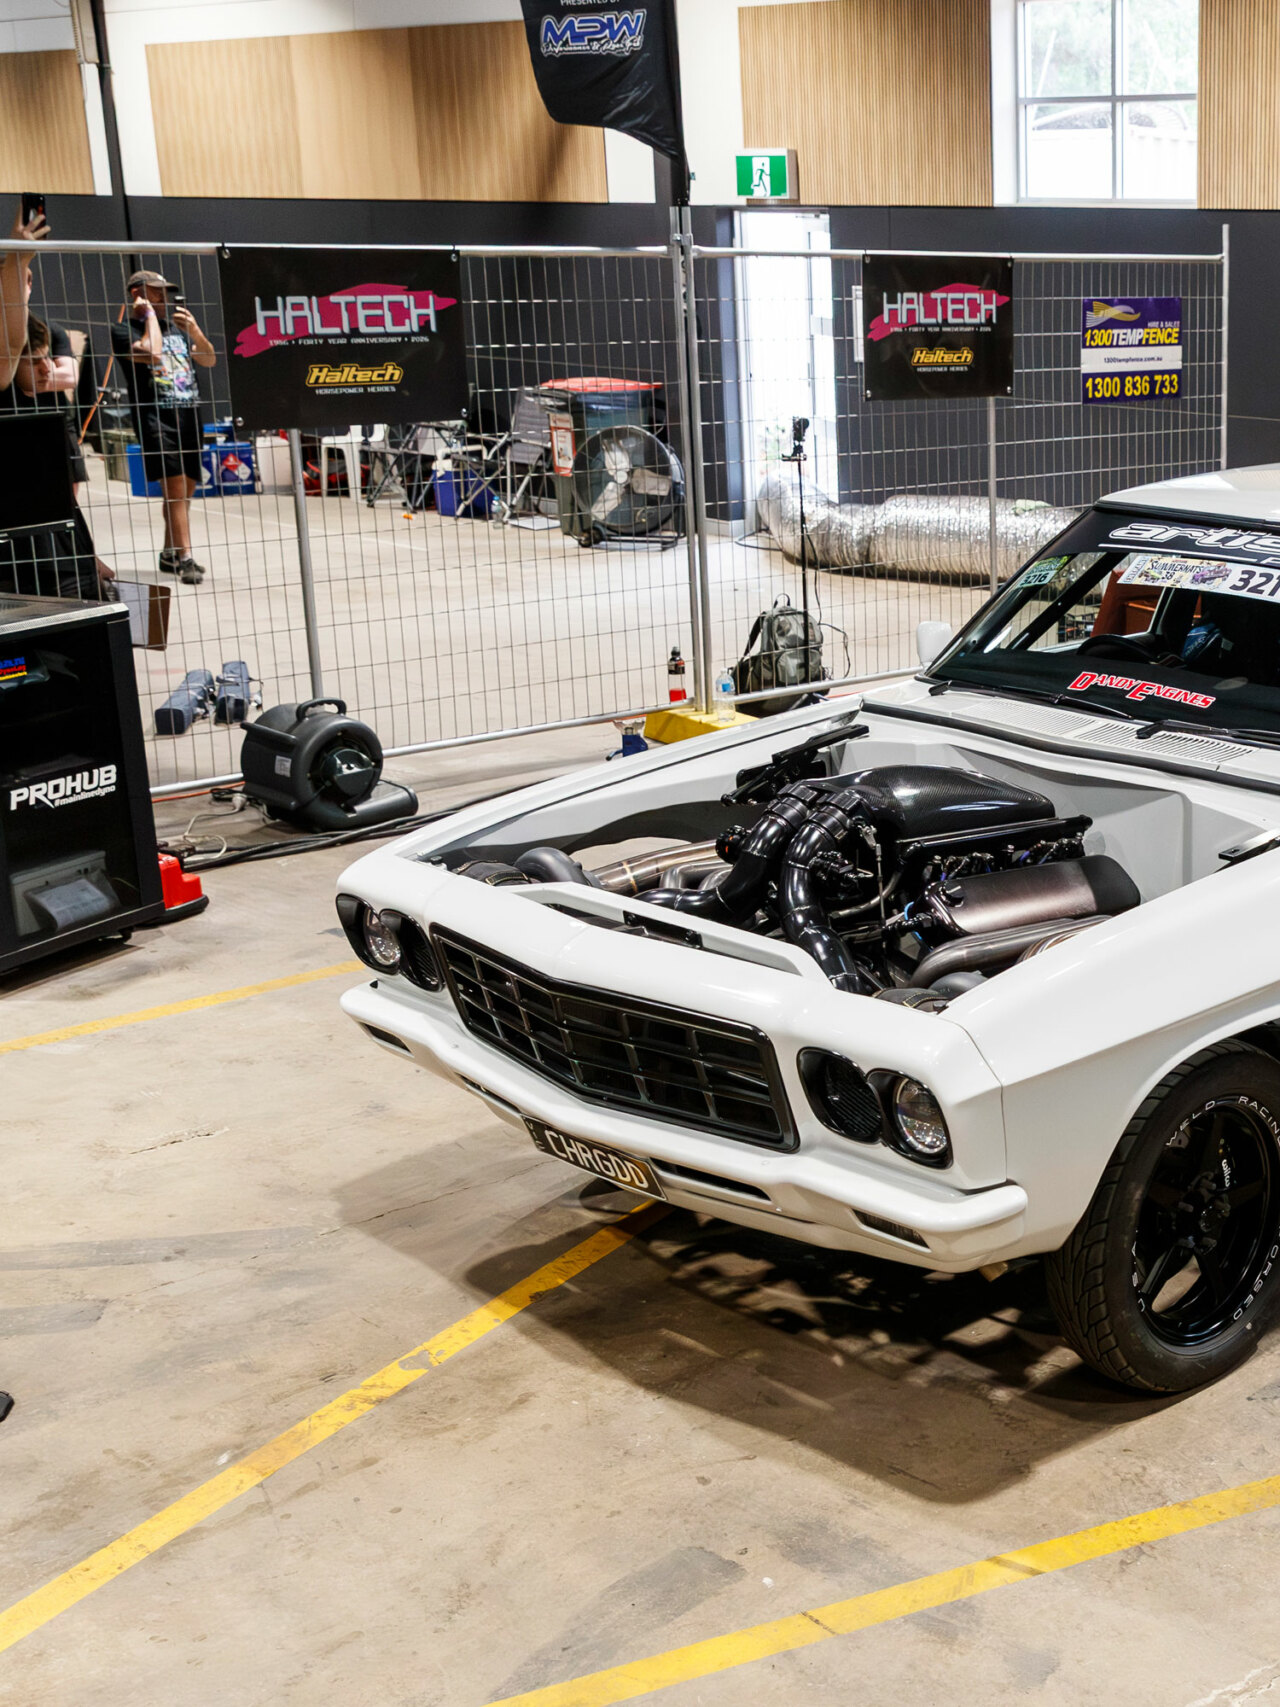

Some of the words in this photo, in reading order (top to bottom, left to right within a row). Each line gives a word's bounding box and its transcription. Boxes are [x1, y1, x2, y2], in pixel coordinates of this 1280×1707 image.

[543, 10, 645, 47] MPW
[255, 295, 437, 335] HALTECH
[883, 292, 997, 324] HALTECH
[299, 337, 324, 345] FORTY
[351, 336, 402, 344] ANNIVERSARY
[1084, 328, 1180, 346] 1300TEMPFENCE
[912, 348, 973, 365] Haltech
[308, 364, 402, 385] Haltech
[316, 387, 364, 395] HORSEPOWER
[1086, 376, 1120, 398] 1300
[1124, 375, 1150, 397] 836
[1154, 374, 1179, 395] 733
[1148, 560, 1204, 574] SUMMERNATS
[1021, 572, 1049, 585] 3216
[10, 764, 117, 811] PROHUB
[1165, 1100, 1216, 1146] WELD
